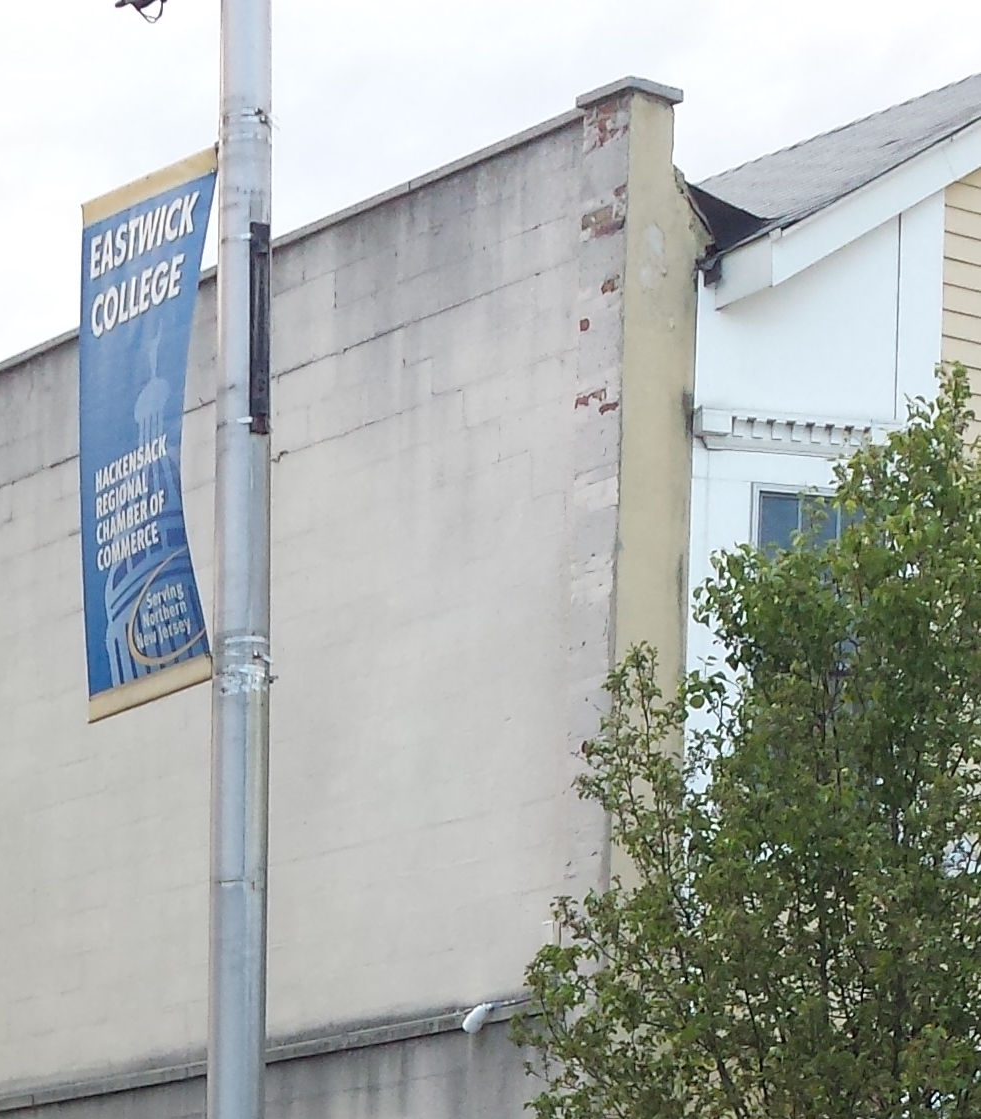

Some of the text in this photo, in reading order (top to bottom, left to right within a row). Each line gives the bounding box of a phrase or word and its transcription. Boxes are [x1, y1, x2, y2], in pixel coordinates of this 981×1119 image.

[89, 190, 201, 280] EASTWICK
[91, 254, 185, 338] COLLEGE
[95, 434, 167, 493] HACKENSACK
[96, 472, 149, 519] REGIONAL
[96, 489, 165, 545] CHAMBER OF
[97, 521, 159, 571] COMMERCE
[142, 602, 187, 628] Northern
[146, 583, 184, 609] Serving
[136, 617, 191, 651] New Jersey
